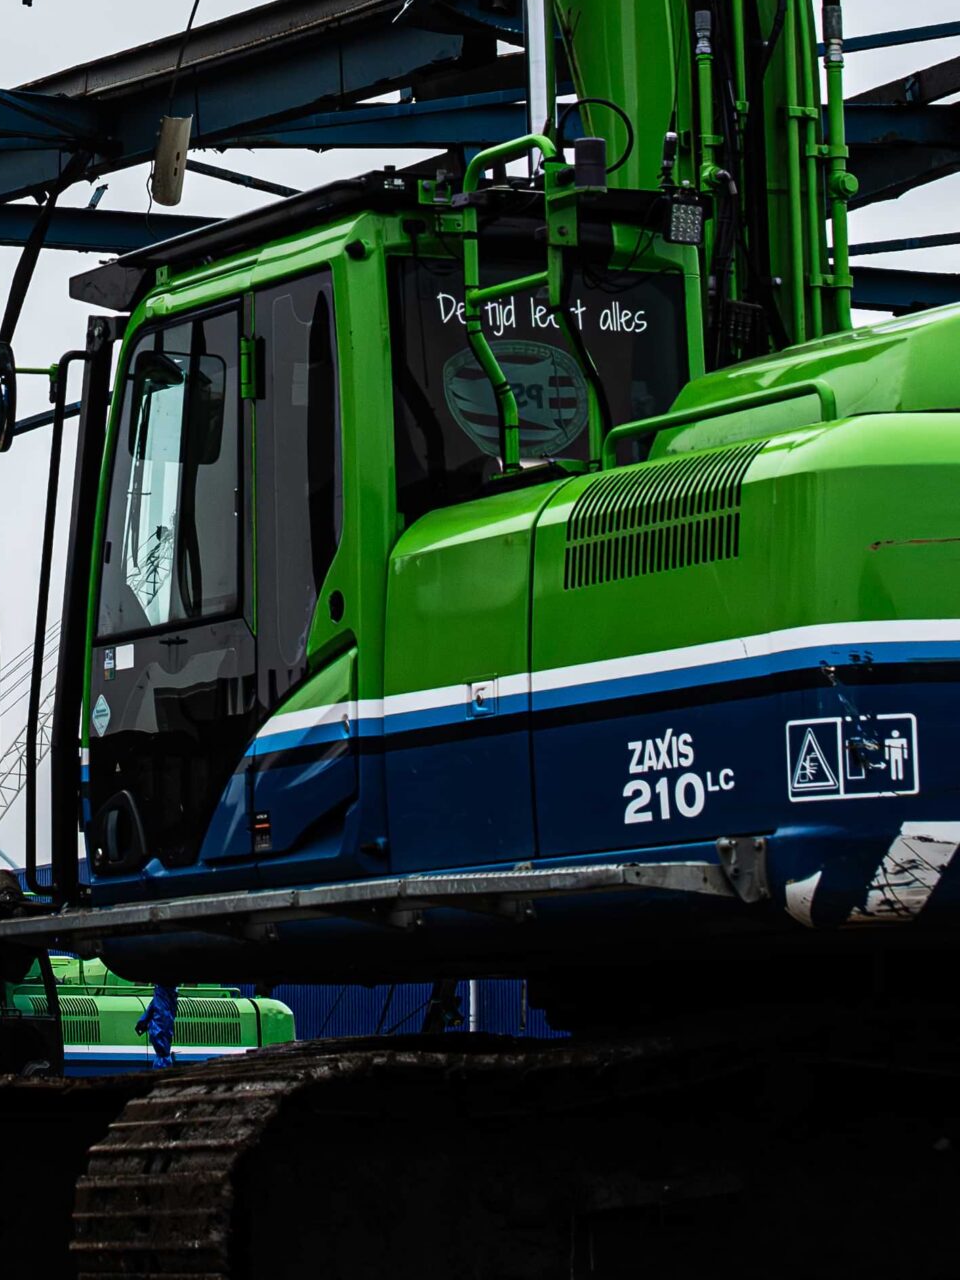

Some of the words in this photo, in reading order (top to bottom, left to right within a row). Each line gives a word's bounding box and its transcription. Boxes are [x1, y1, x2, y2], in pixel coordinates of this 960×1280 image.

[436, 292, 467, 324] De
[484, 295, 516, 336] tijd
[530, 297, 586, 331] let
[600, 300, 647, 333] alles
[627, 728, 694, 774] ZAXIS
